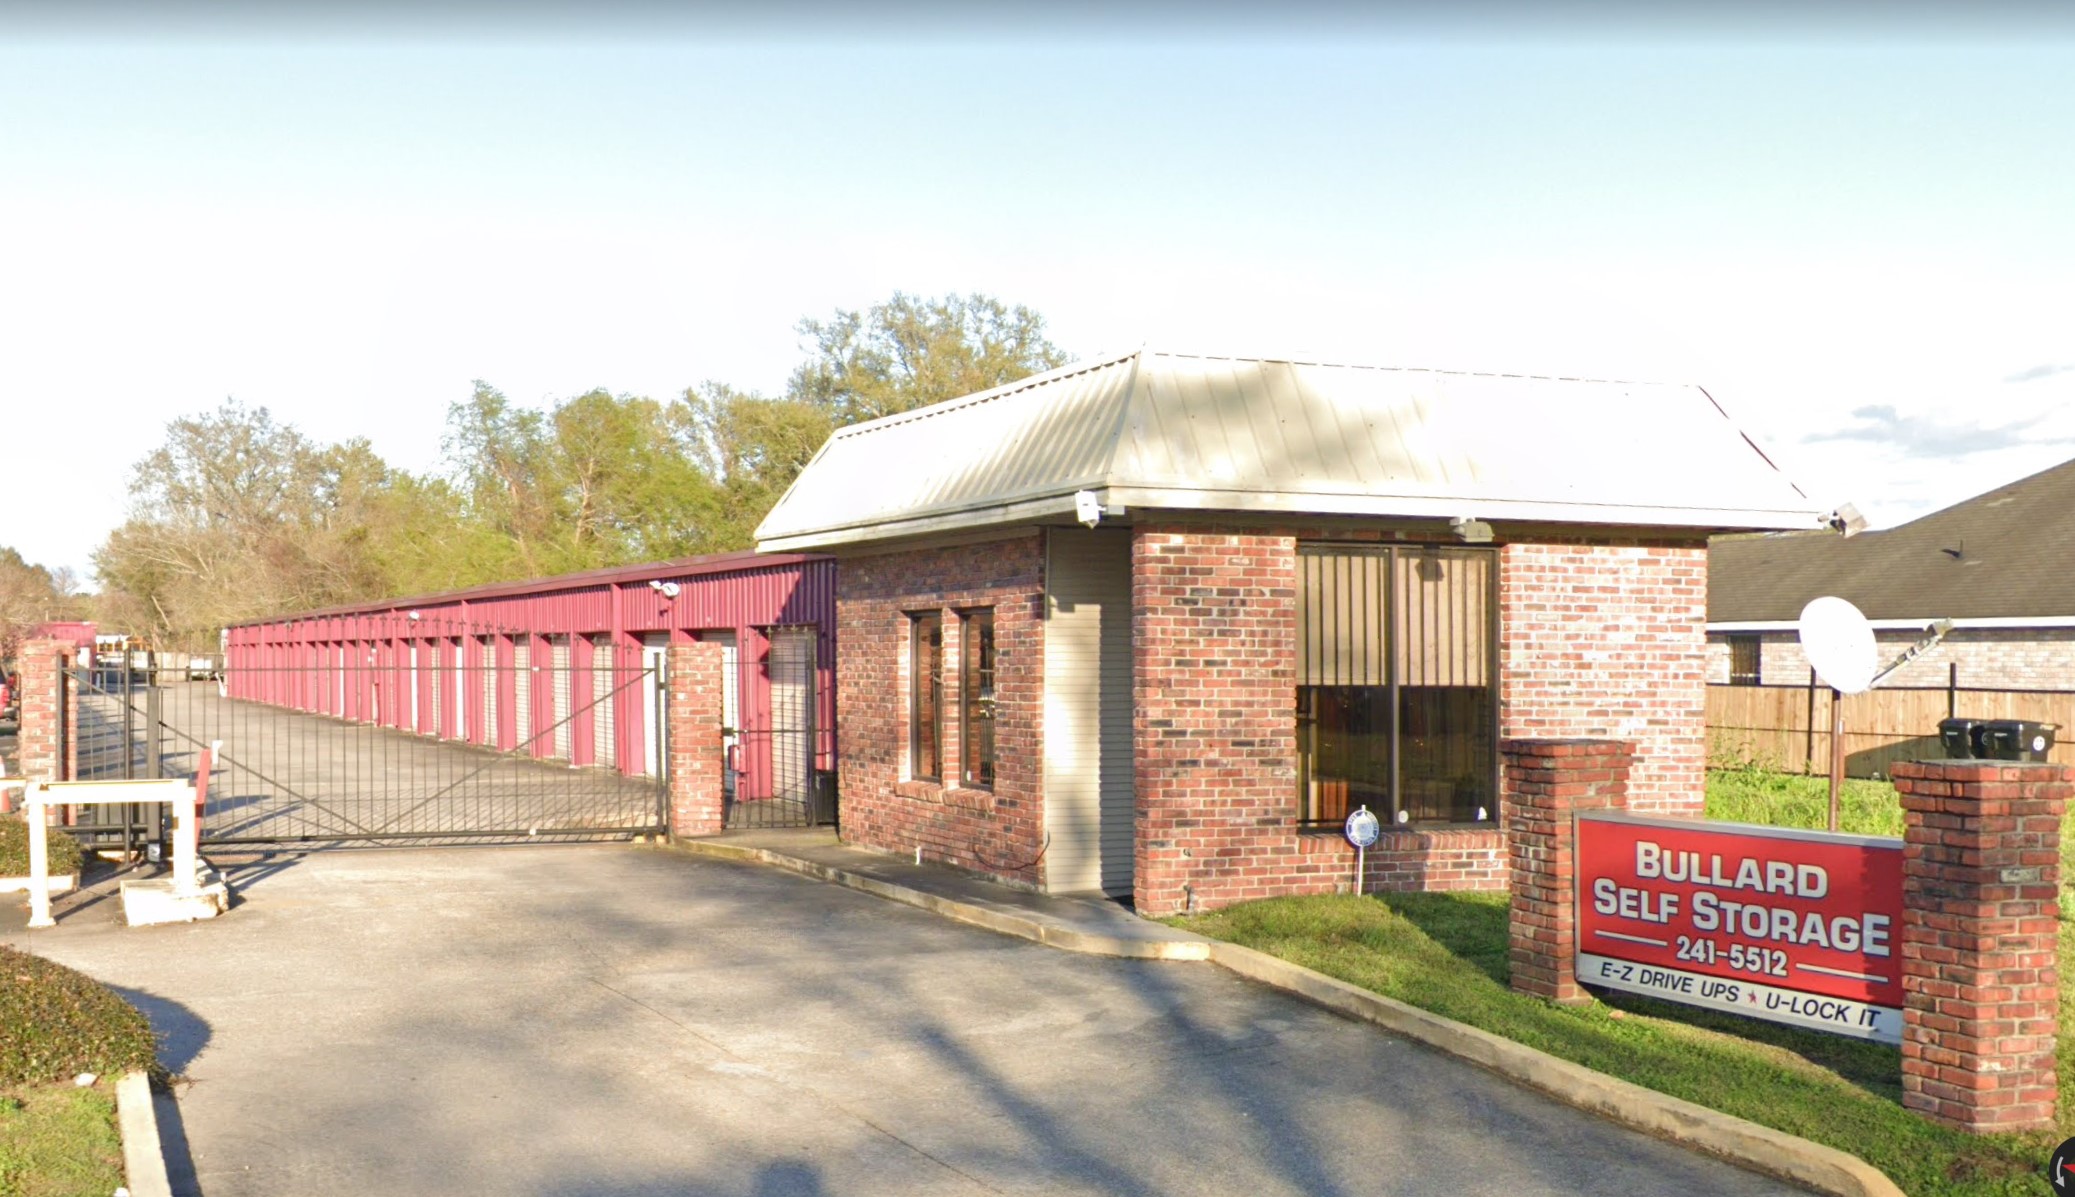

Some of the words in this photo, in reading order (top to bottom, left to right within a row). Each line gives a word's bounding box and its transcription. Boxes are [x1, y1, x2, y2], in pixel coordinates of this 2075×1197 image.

[1636, 841, 1828, 898] BULLARD
[1594, 878, 1679, 923] SELF
[1693, 892, 1890, 956] STORAGE
[1677, 936, 1788, 976] 241-5512
[1601, 962, 1632, 981] E-Z
[1640, 970, 1693, 994] DRIVE
[1700, 981, 1740, 1002] UPS
[1766, 992, 1851, 1023] U-LOCK
[1859, 1009, 1881, 1027] IT
